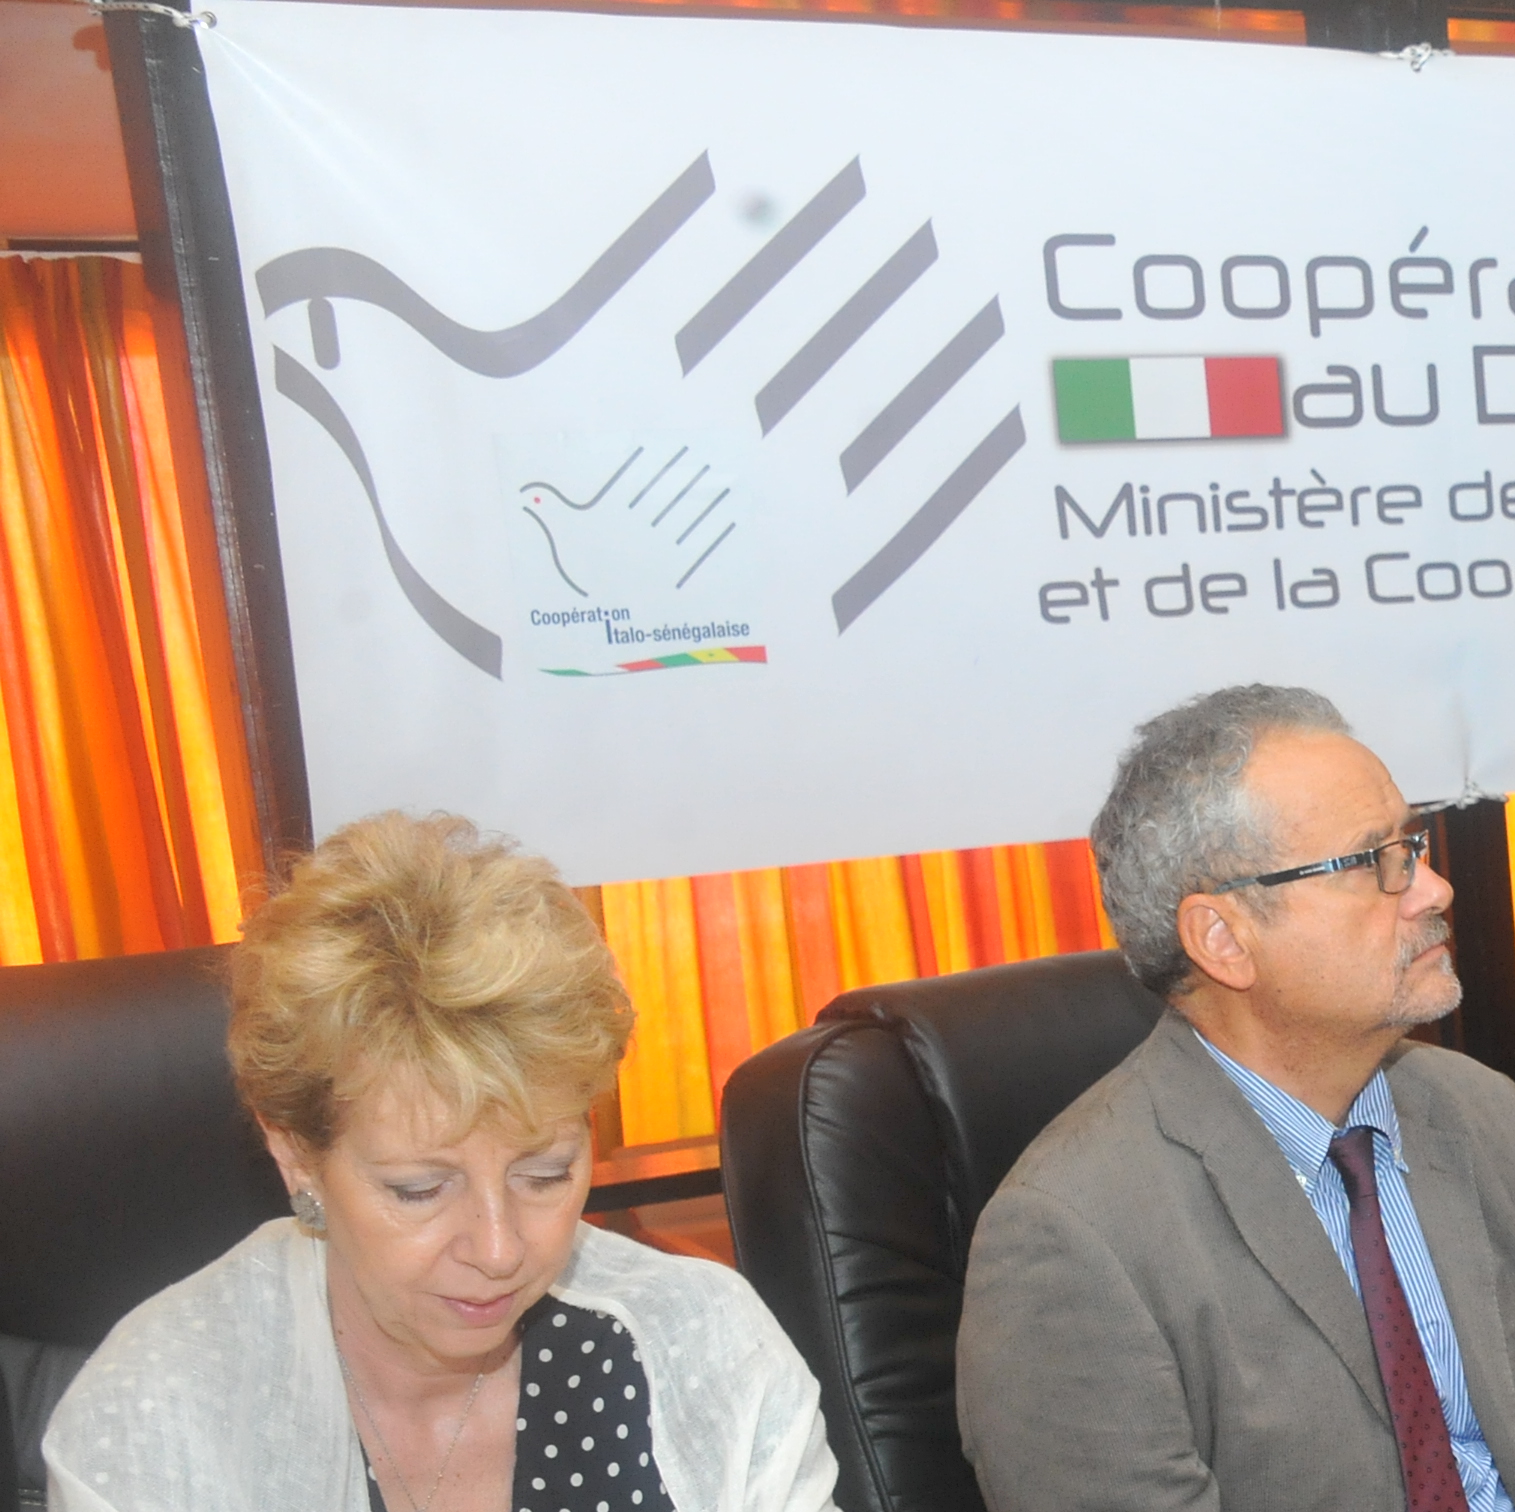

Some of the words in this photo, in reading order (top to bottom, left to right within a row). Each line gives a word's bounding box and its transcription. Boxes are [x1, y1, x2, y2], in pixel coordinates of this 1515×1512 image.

[1293, 363, 1440, 428] au
[1054, 468, 1422, 540] Ministère
[530, 606, 631, 627] Coopération
[1038, 567, 1120, 624] et
[1144, 562, 1248, 618] de
[1273, 557, 1341, 611] la
